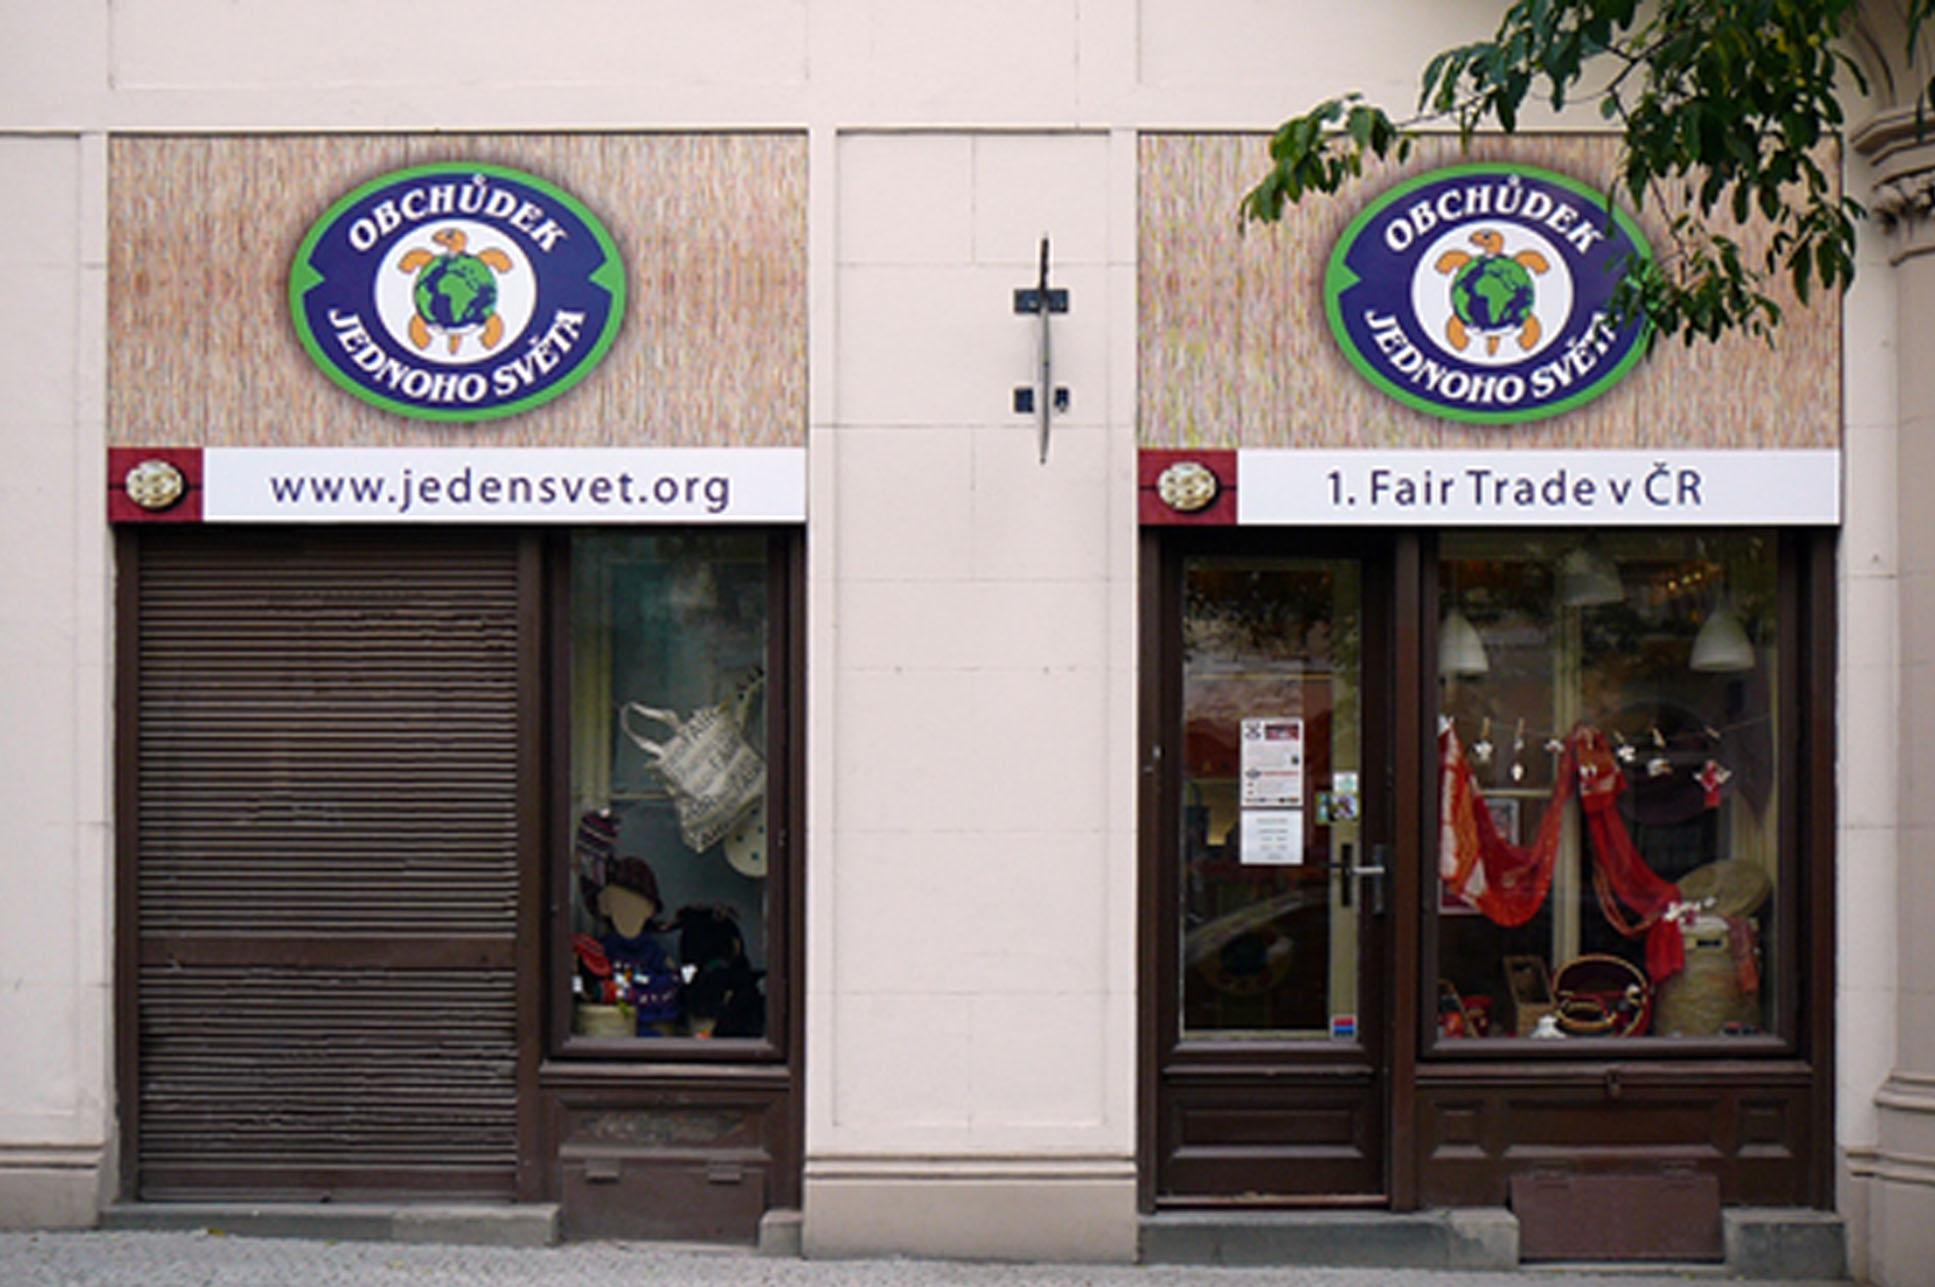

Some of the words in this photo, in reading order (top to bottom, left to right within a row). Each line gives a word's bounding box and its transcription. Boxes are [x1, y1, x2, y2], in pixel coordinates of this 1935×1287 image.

[350, 173, 567, 251] OBCHŮDEK
[1386, 175, 1604, 253] OBCHŮDEK
[329, 309, 488, 402] JEDNOHO
[493, 310, 586, 396] SVĚTA
[1365, 311, 1525, 404] JEDNOHO
[271, 467, 730, 514] www.jedensvet.org
[1329, 470, 1357, 506] 1.
[1370, 469, 1455, 506] Fair
[1465, 470, 1597, 506] Trade
[1609, 479, 1633, 506] v
[1645, 462, 1702, 506] ČR
